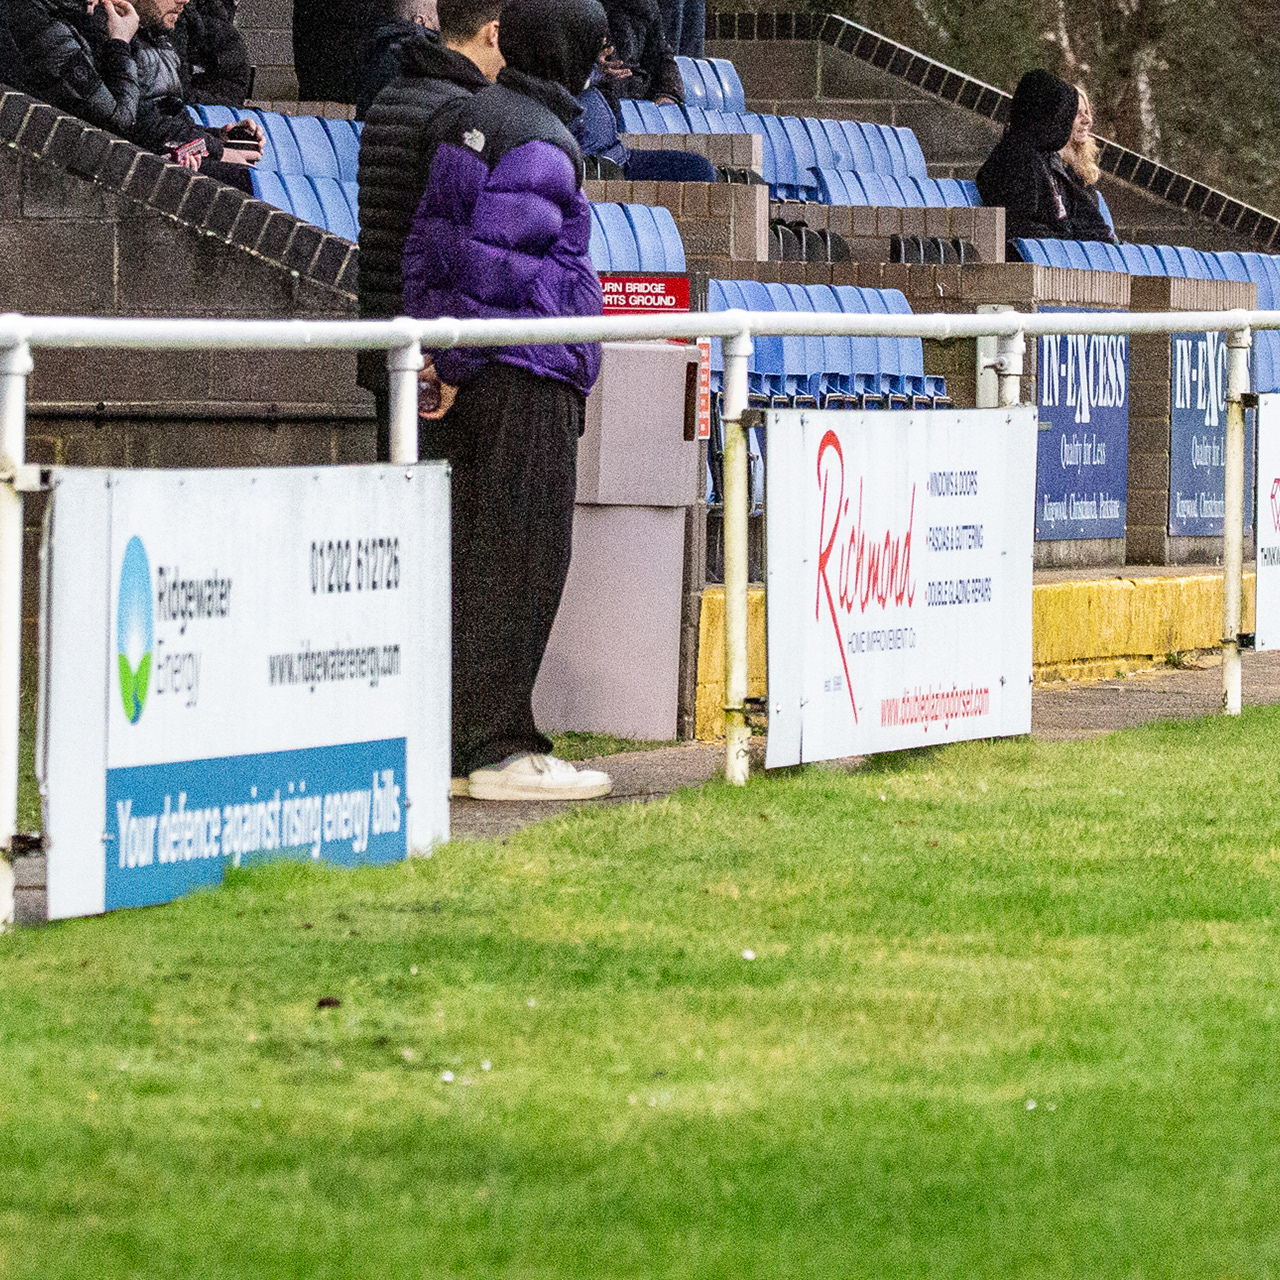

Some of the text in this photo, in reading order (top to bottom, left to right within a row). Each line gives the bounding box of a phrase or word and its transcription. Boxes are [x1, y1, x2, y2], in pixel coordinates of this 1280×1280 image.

[625, 282, 666, 294] BRIDGE
[628, 295, 676, 306] GROUND
[1042, 334, 1126, 423] IN-EXCESS
[1175, 331, 1228, 426] IN-EXC
[1060, 433, 1106, 474] Quality for Less
[959, 470, 977, 496] DOORS
[310, 538, 352, 595] 01202
[816, 429, 916, 725] Richmond
[157, 565, 232, 635] Ridgewater
[268, 640, 402, 692] www.ridgewaterenergy.com
[847, 631, 866, 654] HOME
[866, 627, 908, 652] IMPROVEMENT
[156, 639, 202, 707] Energy
[116, 768, 401, 869] Your defence against rising energy bills
